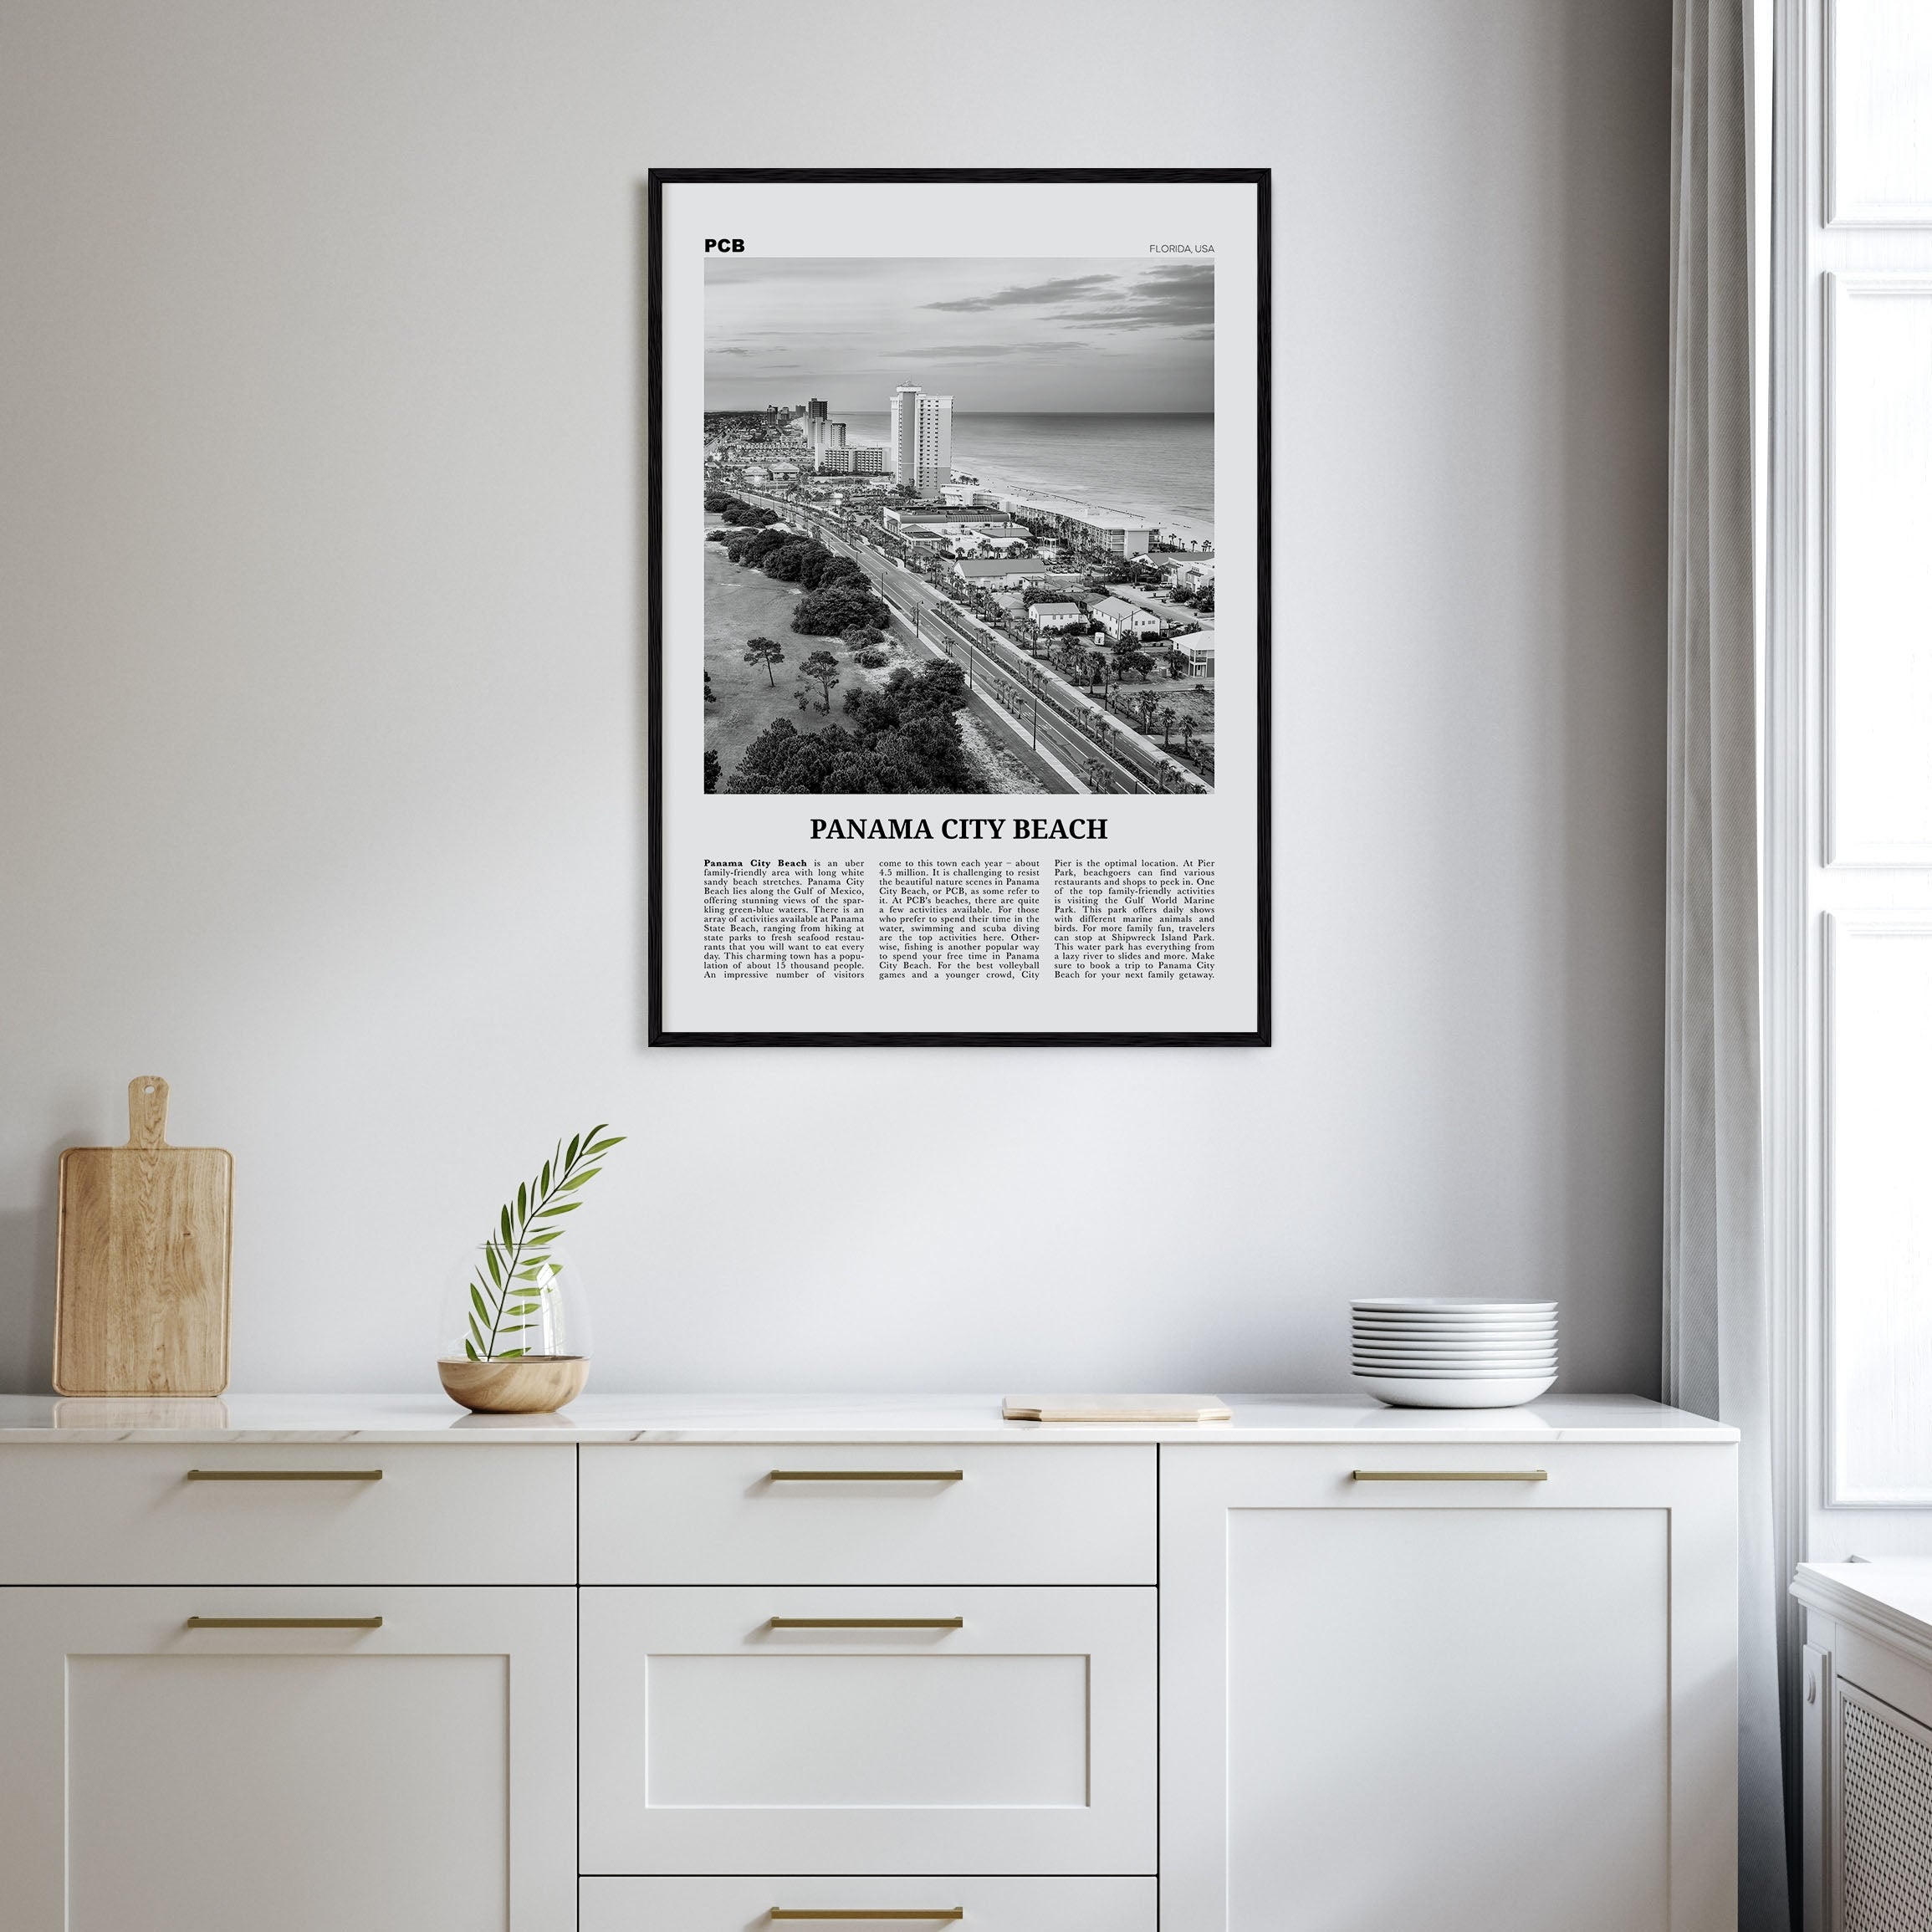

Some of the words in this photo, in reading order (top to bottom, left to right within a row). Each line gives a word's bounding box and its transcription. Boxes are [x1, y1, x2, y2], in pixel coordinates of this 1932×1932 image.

[704, 238, 745, 253] PCB
[1149, 244, 1193, 253] FLORIDA,
[1195, 244, 1215, 253] USA
[810, 819, 934, 839] PANAMA
[941, 819, 1006, 839] CITY
[1012, 819, 1108, 839] BEACH
[750, 860, 771, 869] City
[703, 869, 767, 878] family-friendly
[818, 869, 837, 878] long
[1055, 869, 1076, 877] Park,
[1083, 869, 1131, 878] beachgoers
[703, 878, 728, 887] sandy
[846, 878, 865, 887] City
[1067, 897, 1099, 906] visiting
[703, 906, 725, 915] kling
[728, 906, 774, 915] green-blue
[1107, 906, 1127, 915] park
[1163, 906, 1184, 915] daily
[703, 924, 725, 933] State
[730, 924, 759, 933] Beach,
[764, 924, 796, 934] ranging
[800, 924, 820, 933] from
[825, 924, 852, 934] hiking
[879, 925, 905, 933] water,
[911, 924, 954, 934] swimming
[960, 924, 976, 933] and
[982, 924, 1007, 933] scuba
[1013, 924, 1040, 934] diving
[1054, 924, 1078, 933] birds.
[1082, 924, 1096, 933] For
[1127, 924, 1153, 934] family
[1158, 924, 1174, 933] fun,
[1178, 924, 1215, 933] travelers
[728, 933, 752, 943] parks
[771, 933, 792, 942] fresh
[797, 933, 830, 942] seafood
[899, 933, 912, 942] the
[918, 934, 933, 943] top
[938, 933, 977, 942] activities
[983, 933, 1004, 942] here.
[1010, 933, 1040, 942] Other-
[1075, 934, 1092, 943] stop
[1112, 933, 1156, 943] Shipwreck
[1161, 933, 1188, 942] Island
[1193, 933, 1214, 942] Park.
[879, 943, 900, 952] wise,
[904, 943, 933, 953] fishing
[937, 943, 944, 951] is
[948, 943, 981, 951] another
[985, 943, 1019, 953] popular
[1054, 943, 1074, 951] This
[1105, 943, 1124, 953] park
[1128, 943, 1142, 951] has
[1146, 943, 1191, 953] everything
[1194, 943, 1214, 951] from
[892, 952, 917, 962] spend
[947, 952, 963, 960] free
[968, 952, 987, 960] time
[992, 952, 1000, 960] in
[1006, 952, 1040, 960] Panama
[879, 962, 897, 971] City
[999, 962, 1040, 971] volleyball
[724, 971, 769, 980] impressive
[986, 971, 1015, 979] crowd,
[1021, 971, 1040, 980] City
[1147, 971, 1174, 980] family
[1178, 971, 1214, 980] getaway.
